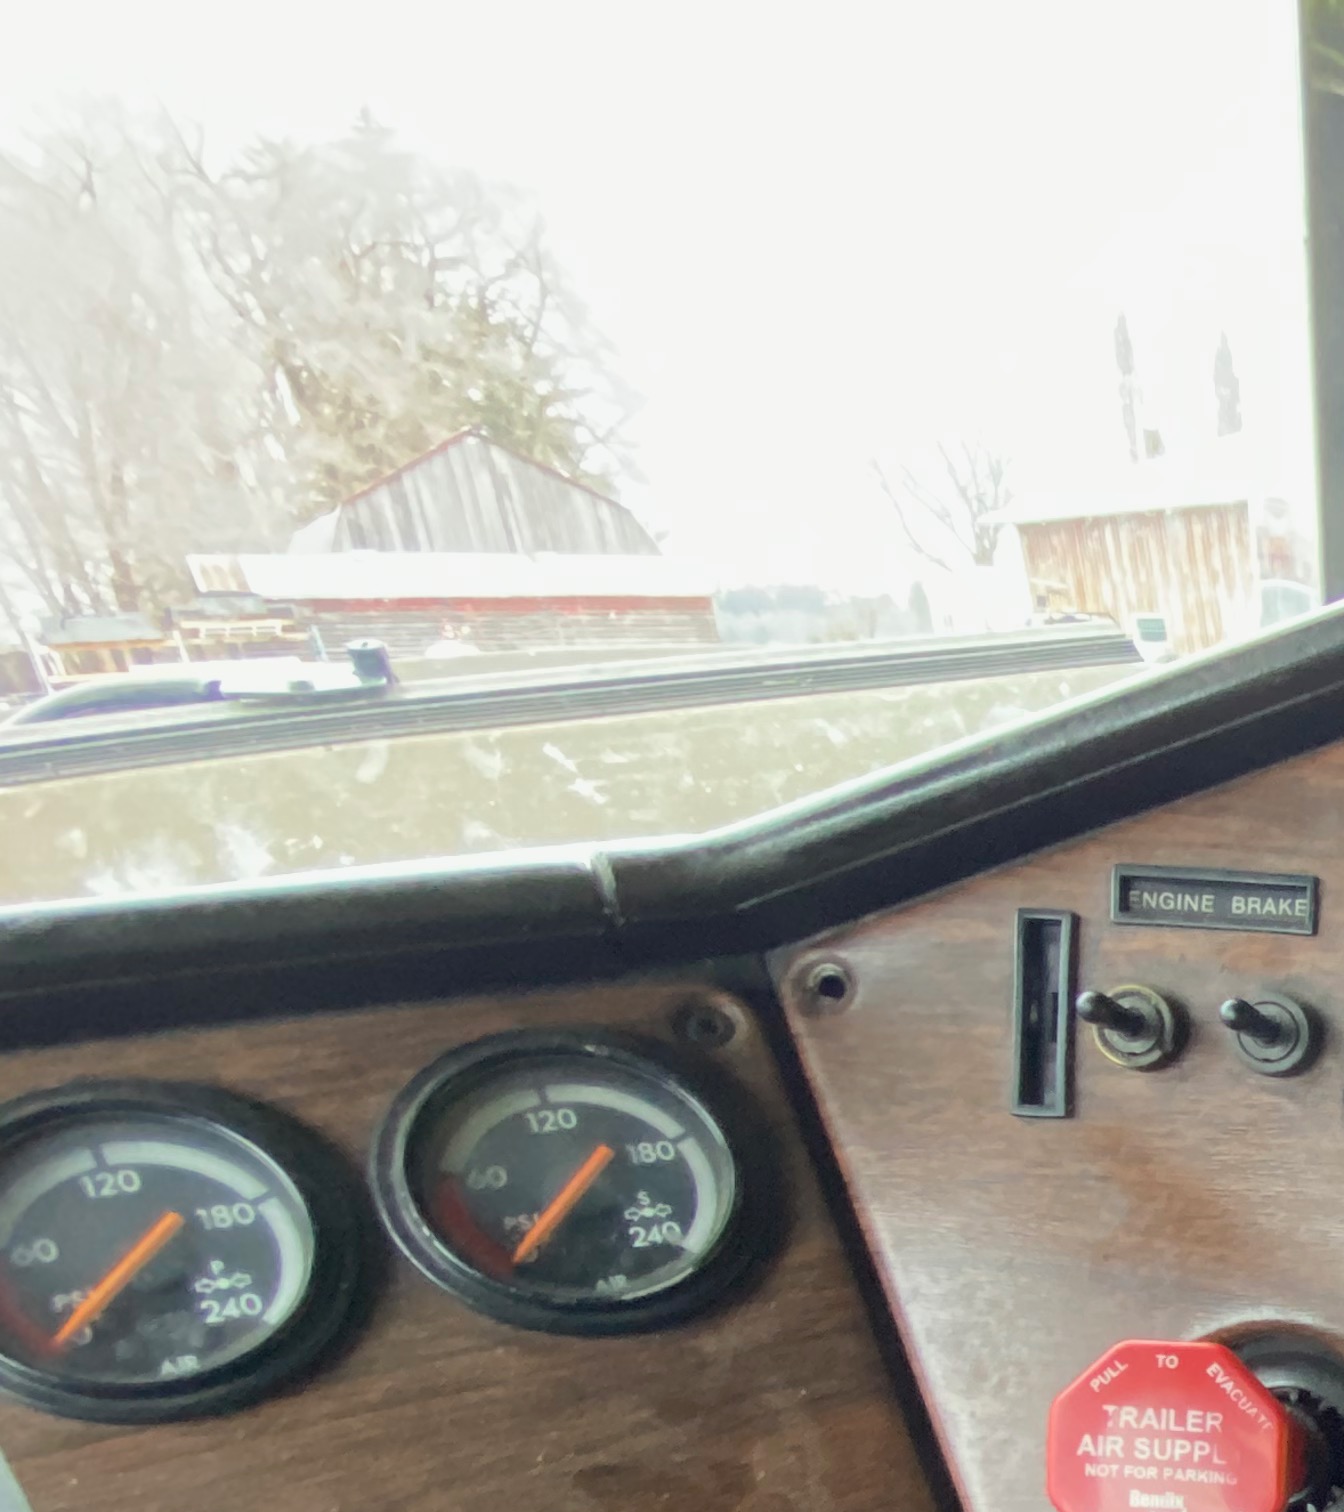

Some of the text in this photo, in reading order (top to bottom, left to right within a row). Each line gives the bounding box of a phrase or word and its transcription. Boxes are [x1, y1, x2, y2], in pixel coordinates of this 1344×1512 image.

[1129, 889, 1309, 918] ENGINE BRAKE
[525, 1108, 578, 1133] 120
[626, 1140, 676, 1165] 180
[79, 1169, 141, 1198] 120
[467, 1165, 508, 1190] 60
[638, 1190, 650, 1205] S
[195, 1202, 256, 1231] 180
[628, 1221, 684, 1248] 240
[210, 1260, 225, 1275] P
[200, 1293, 262, 1324] 240
[159, 1355, 199, 1376] AIR
[1089, 1354, 1274, 1430] PULL TO EVACUATE
[1102, 1404, 1223, 1433] TRAILER
[1077, 1434, 1227, 1465] AIR SUPPL
[1085, 1463, 1238, 1486] NOT FOR PARKING
[1129, 1489, 1185, 1510] Bendix
